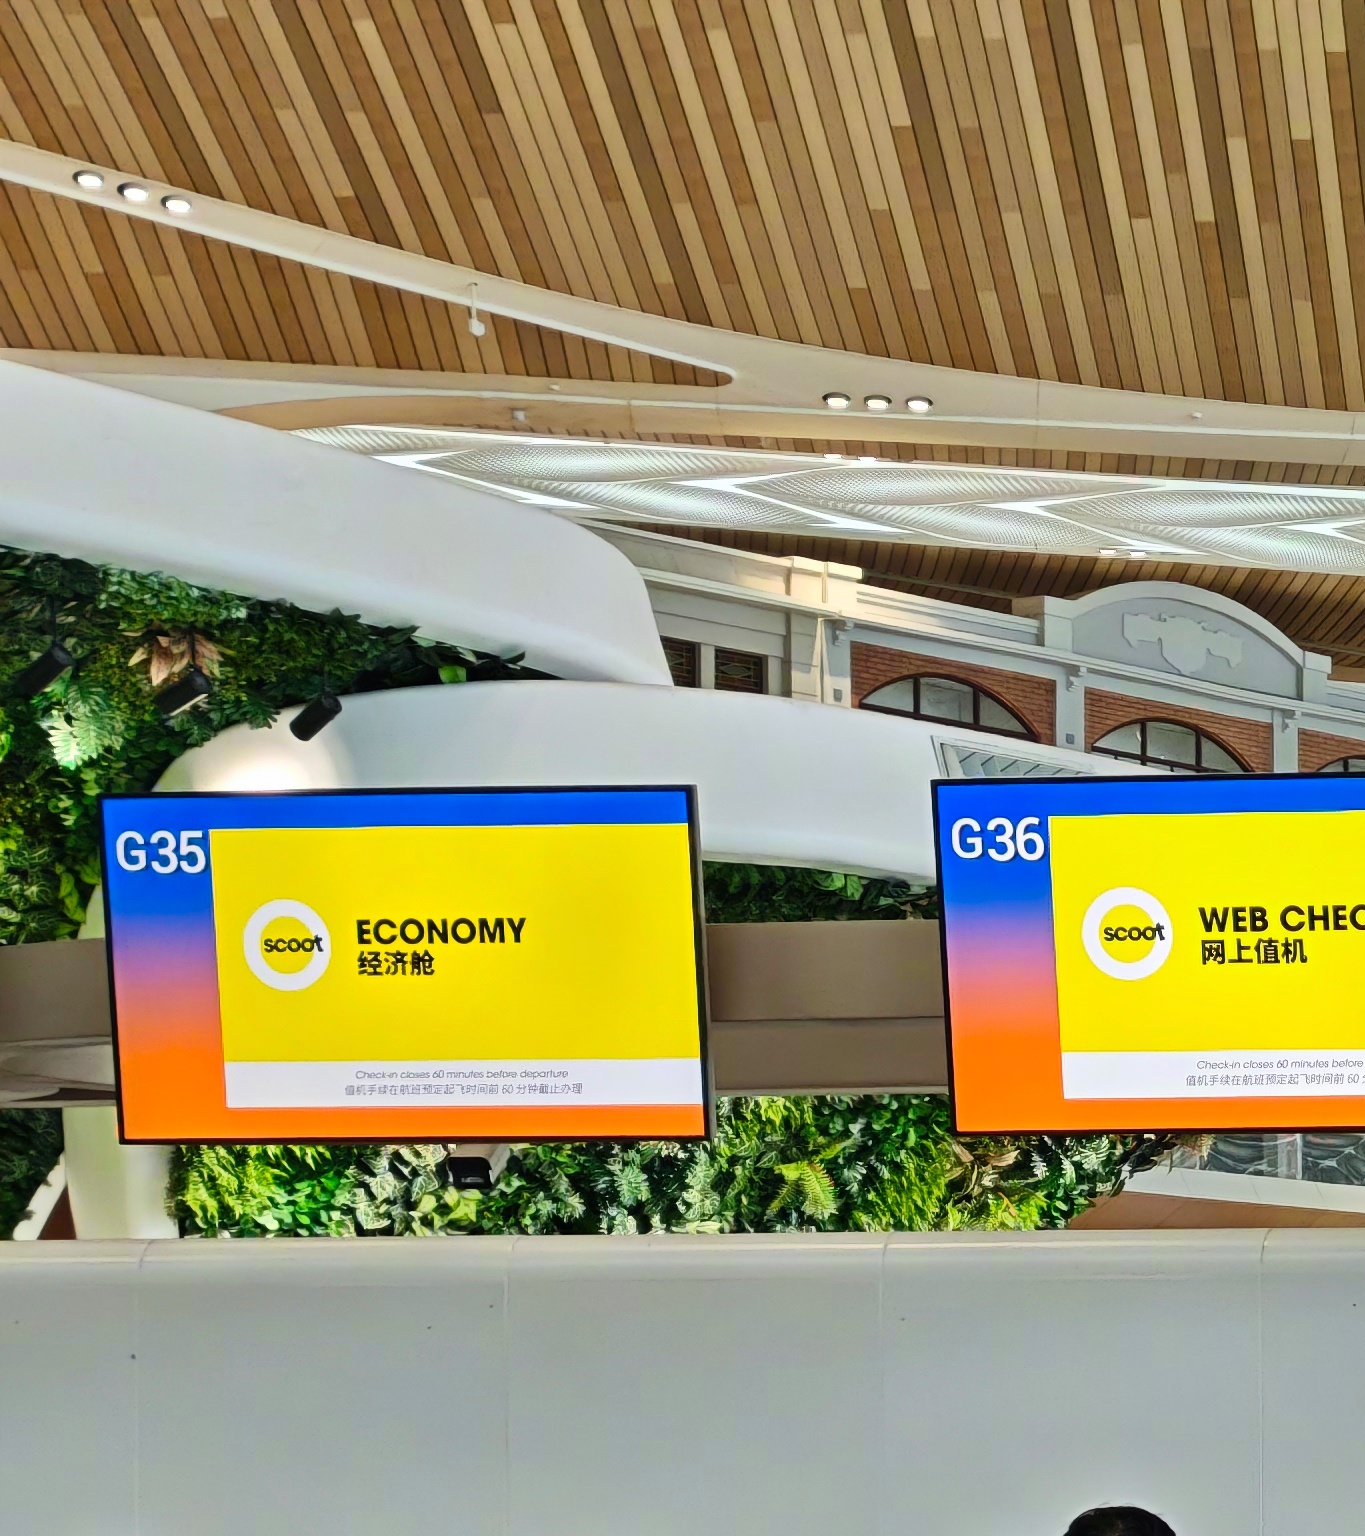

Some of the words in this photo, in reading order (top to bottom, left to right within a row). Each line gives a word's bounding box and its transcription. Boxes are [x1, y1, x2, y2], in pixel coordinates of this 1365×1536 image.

[116, 830, 206, 874] G35
[951, 816, 1044, 861] G36
[356, 917, 527, 945] ECONOMY
[1103, 922, 1166, 942] scoot
[1198, 905, 1268, 932] WEB
[263, 934, 324, 954] scoot
[1201, 938, 1308, 965] 网上值机
[357, 950, 435, 976] 经济舱
[1196, 1060, 1241, 1070] Check-in
[1243, 1060, 1274, 1069] closes
[1276, 1059, 1289, 1069] 60
[1291, 1060, 1329, 1069] minutes
[1331, 1059, 1364, 1068] before
